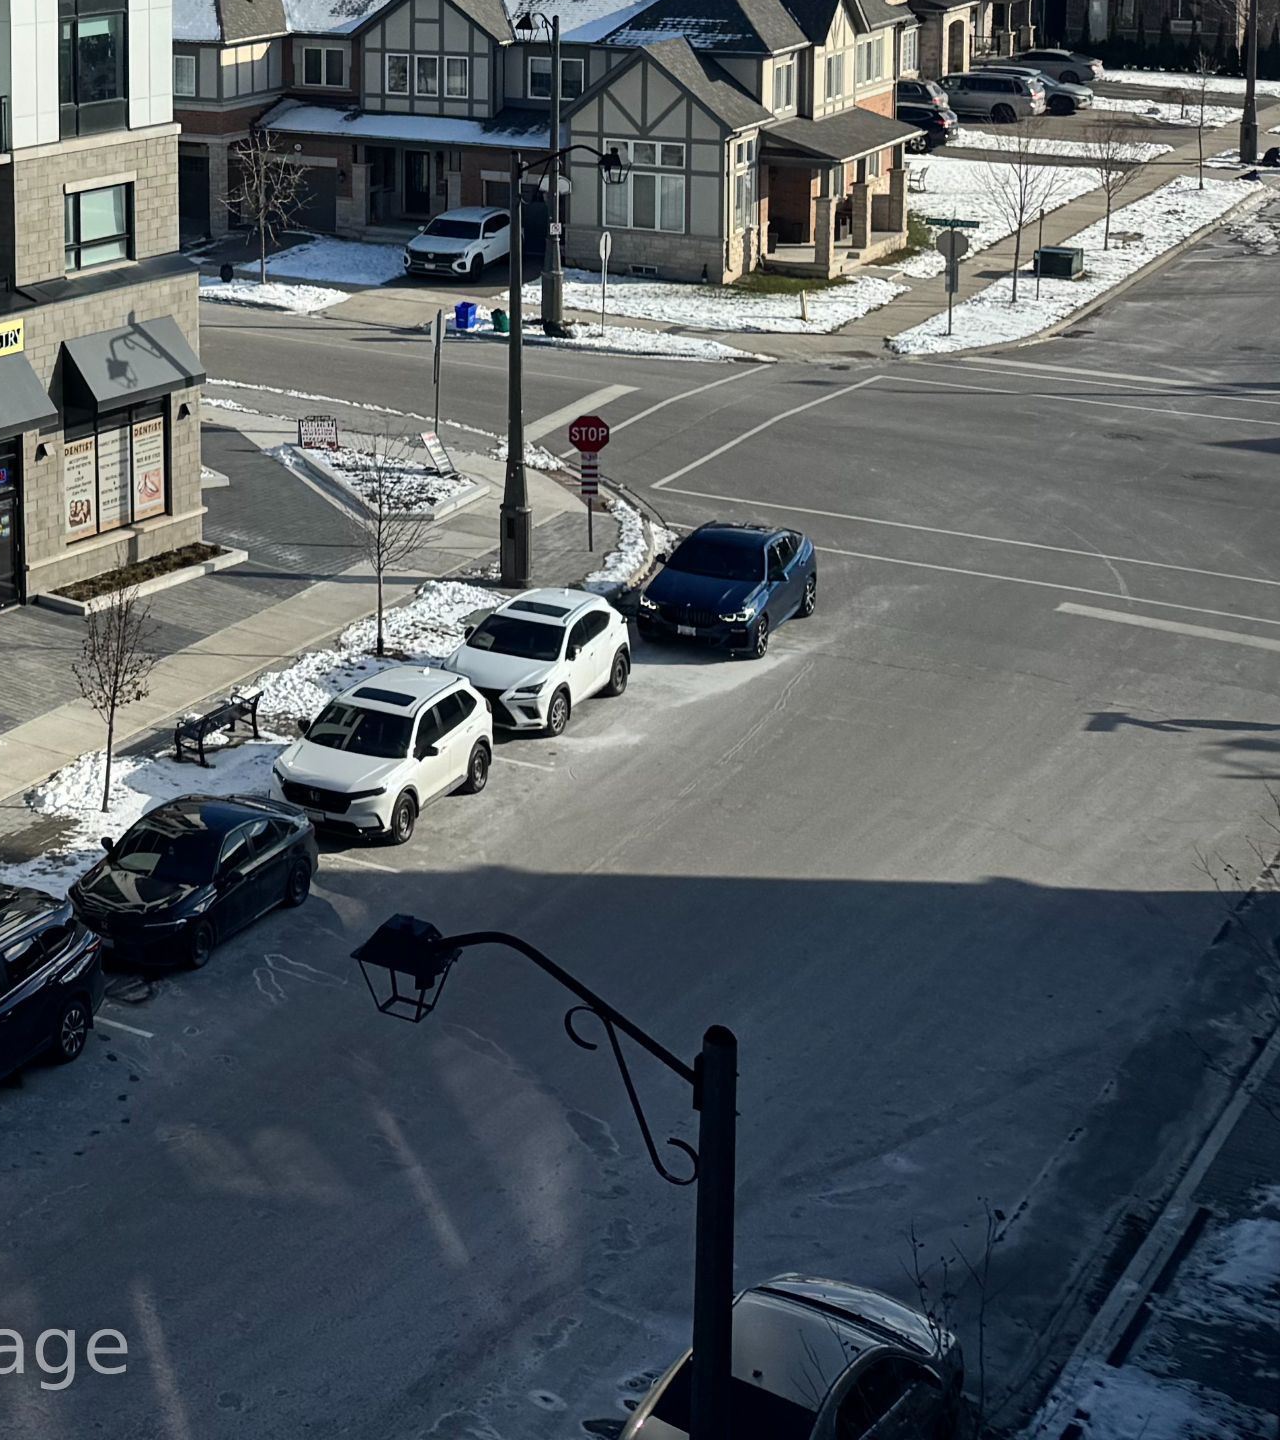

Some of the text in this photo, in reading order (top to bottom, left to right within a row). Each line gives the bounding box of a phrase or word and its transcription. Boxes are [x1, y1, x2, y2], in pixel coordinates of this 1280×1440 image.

[134, 421, 161, 437] DENTIST
[571, 427, 607, 442] STOP
[64, 441, 92, 456] DENTIST
